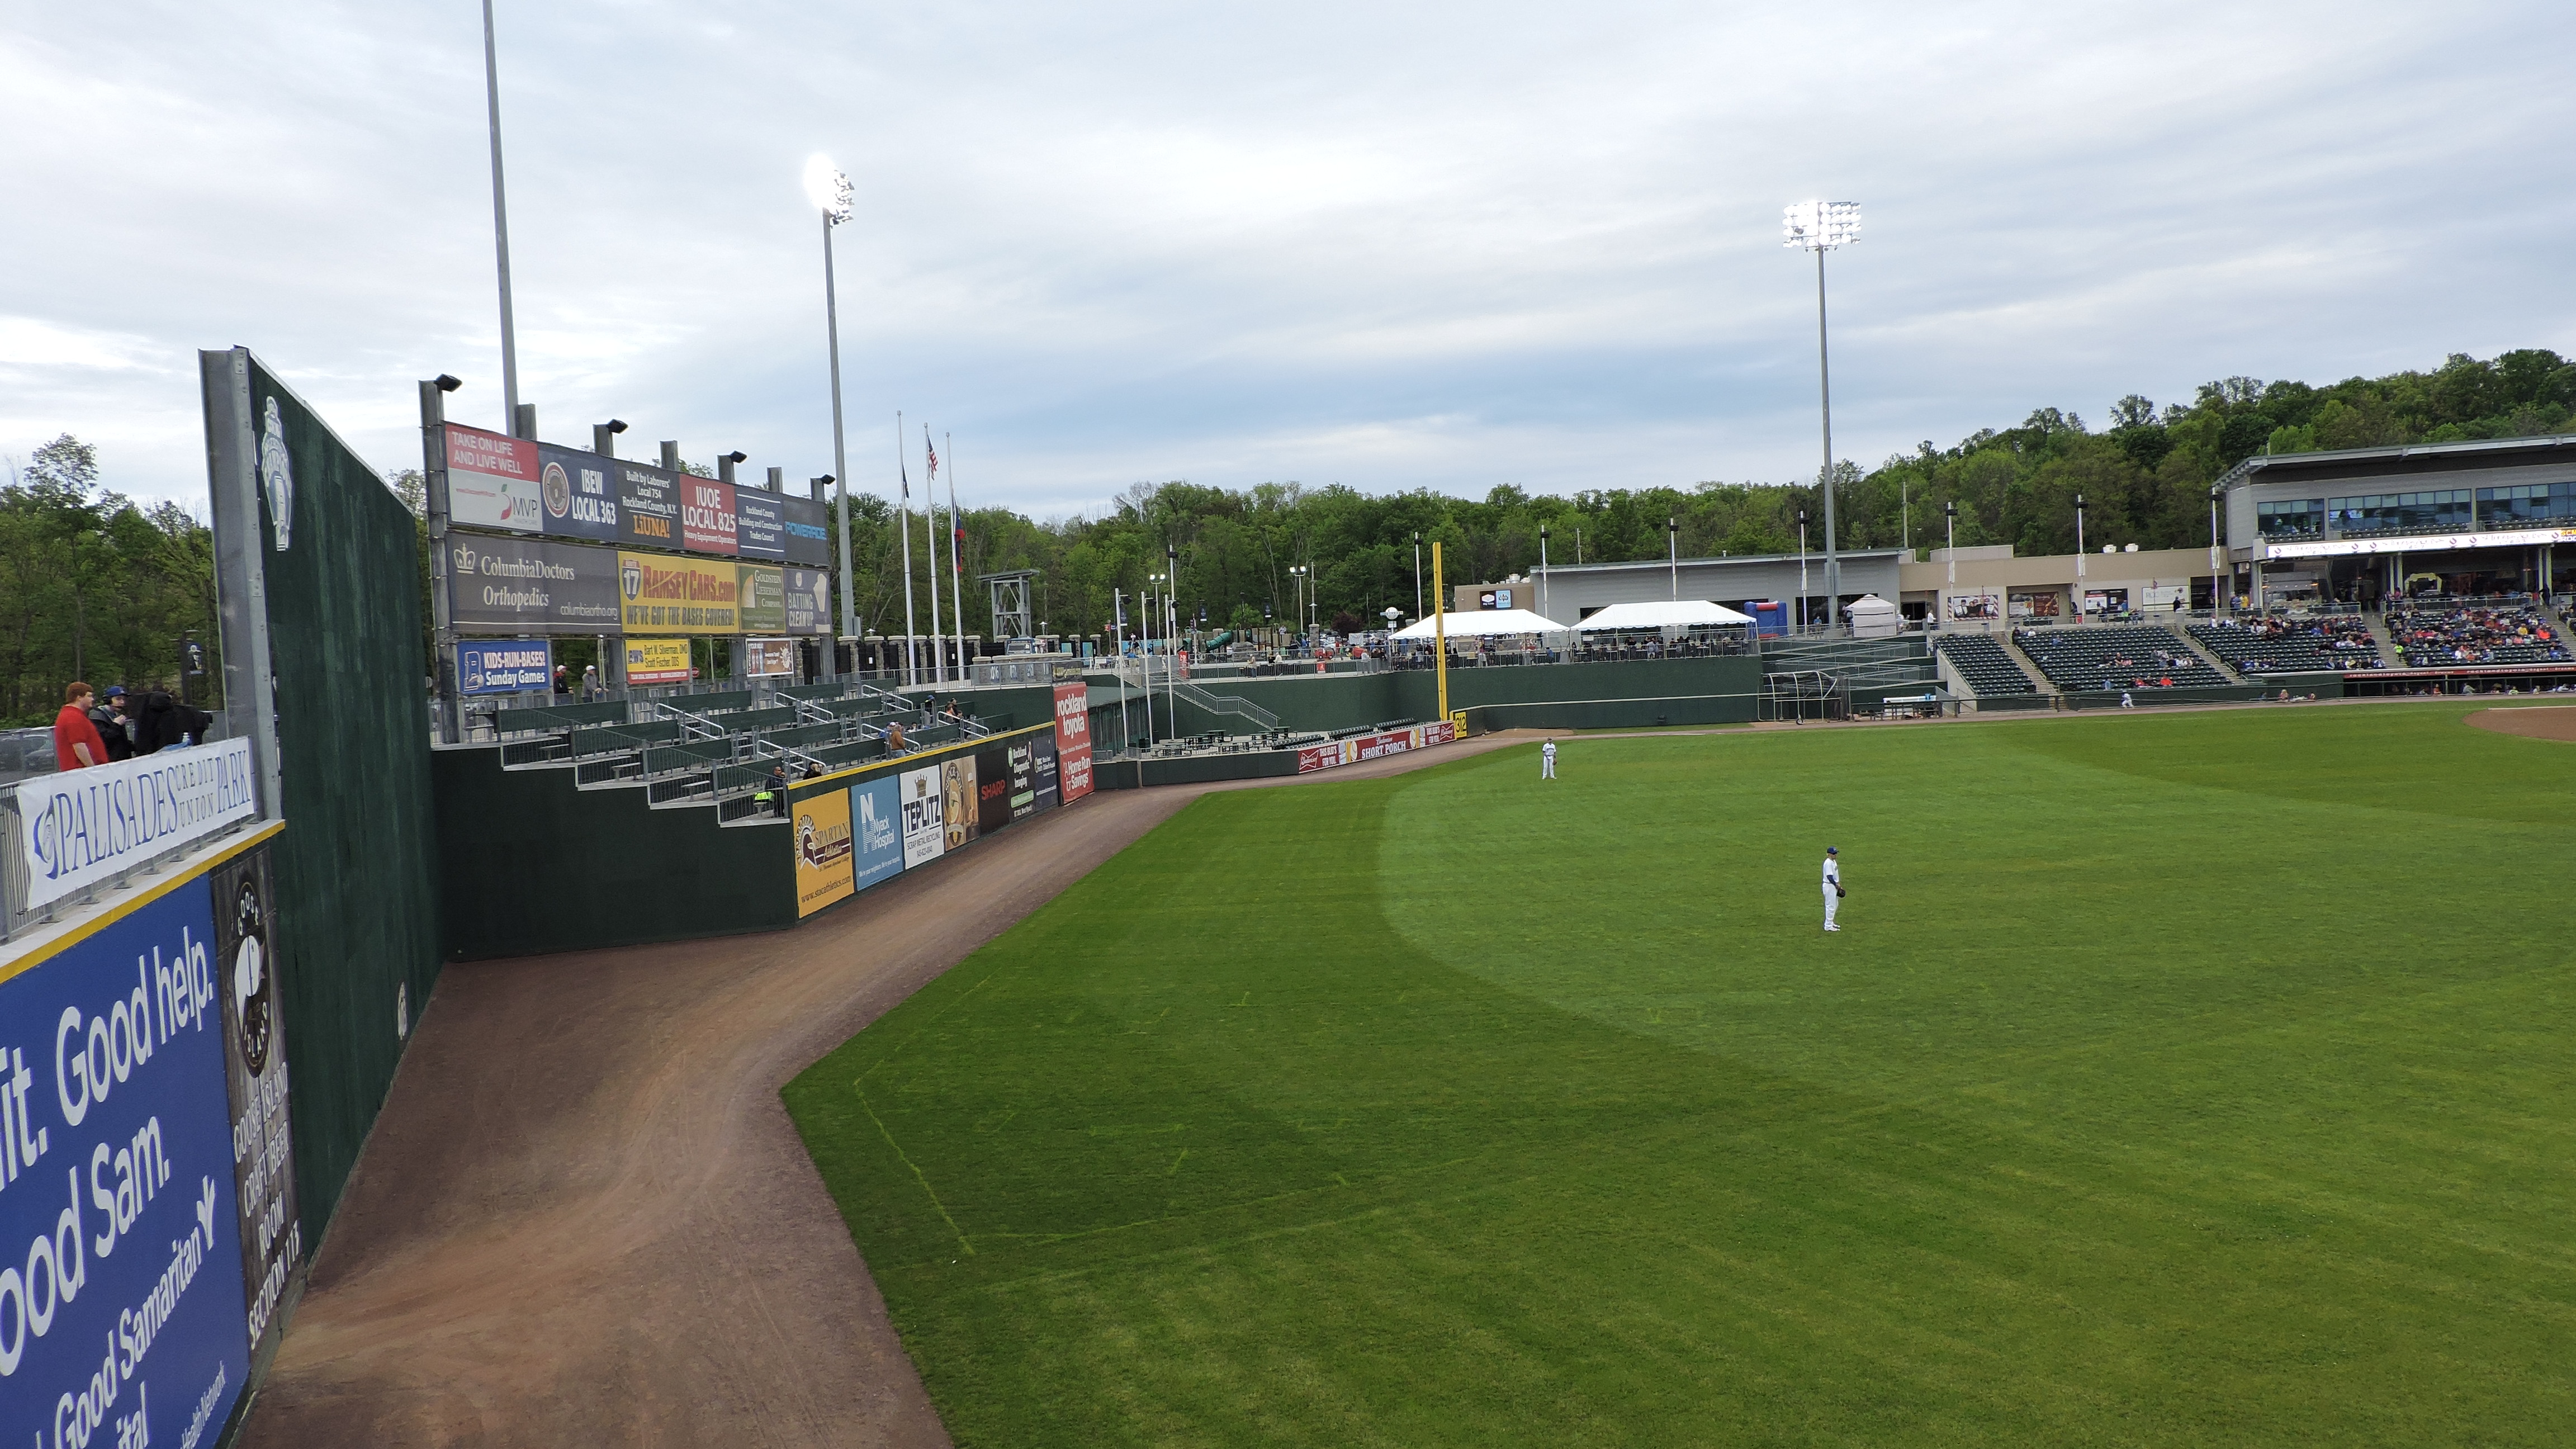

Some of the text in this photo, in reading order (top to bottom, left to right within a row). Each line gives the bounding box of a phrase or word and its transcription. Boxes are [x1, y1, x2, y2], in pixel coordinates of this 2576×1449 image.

[452, 432, 513, 456] TAKE ON LIFE
[454, 450, 523, 474] AND LIVE WELL
[581, 468, 603, 495] IBEW
[626, 470, 639, 482] Built
[639, 472, 647, 486] by
[622, 495, 647, 509] Rockland
[637, 485, 662, 499] Local 754
[695, 486, 721, 509] IUOE
[513, 496, 537, 518] MVP
[571, 495, 615, 525] LOCAL 363
[682, 504, 736, 533] LOCAL 825
[633, 514, 670, 538] LiUNA!
[784, 520, 827, 540] POWERADE
[481, 555, 575, 581] ColumbiaDoctors
[623, 570, 639, 595] 17
[484, 585, 549, 612] Orthopedics
[788, 593, 813, 610] BATTING
[627, 605, 649, 625] WE'VE
[651, 606, 665, 625] GOT
[667, 607, 680, 626] THE
[682, 607, 703, 626] BASES
[484, 651, 546, 669] KIDS-RUN-BASES!
[486, 669, 546, 688] Sunday Games
[1057, 691, 1088, 717] rockland
[1063, 713, 1086, 740] toyota
[1456, 716, 1467, 733] 312
[1361, 740, 1407, 759] SHORT PORCH
[174, 757, 215, 792] CREDIT
[1068, 760, 1082, 776] Home
[1081, 756, 1091, 770] Run
[214, 749, 251, 815] PARK
[981, 779, 1006, 801] SHARP
[55, 765, 178, 876] PALISADES
[179, 792, 215, 828] UNION
[903, 794, 941, 833] TEPLITZ
[815, 821, 849, 847] SPARTAN
[874, 815, 889, 835] Nyack
[874, 828, 895, 850] Hospital
[238, 891, 259, 936] GOOSE
[56, 955, 153, 1126] Good
[153, 925, 214, 1045] help.
[233, 1060, 288, 1164] GOOSE ISLAND
[244, 1120, 291, 1219] CRAFT BEER
[91, 1116, 170, 1258] Sam.
[258, 1189, 286, 1262] ROOM
[249, 1218, 301, 1352] SECTION 113
[55, 1226, 201, 1449] Good Samaritan
